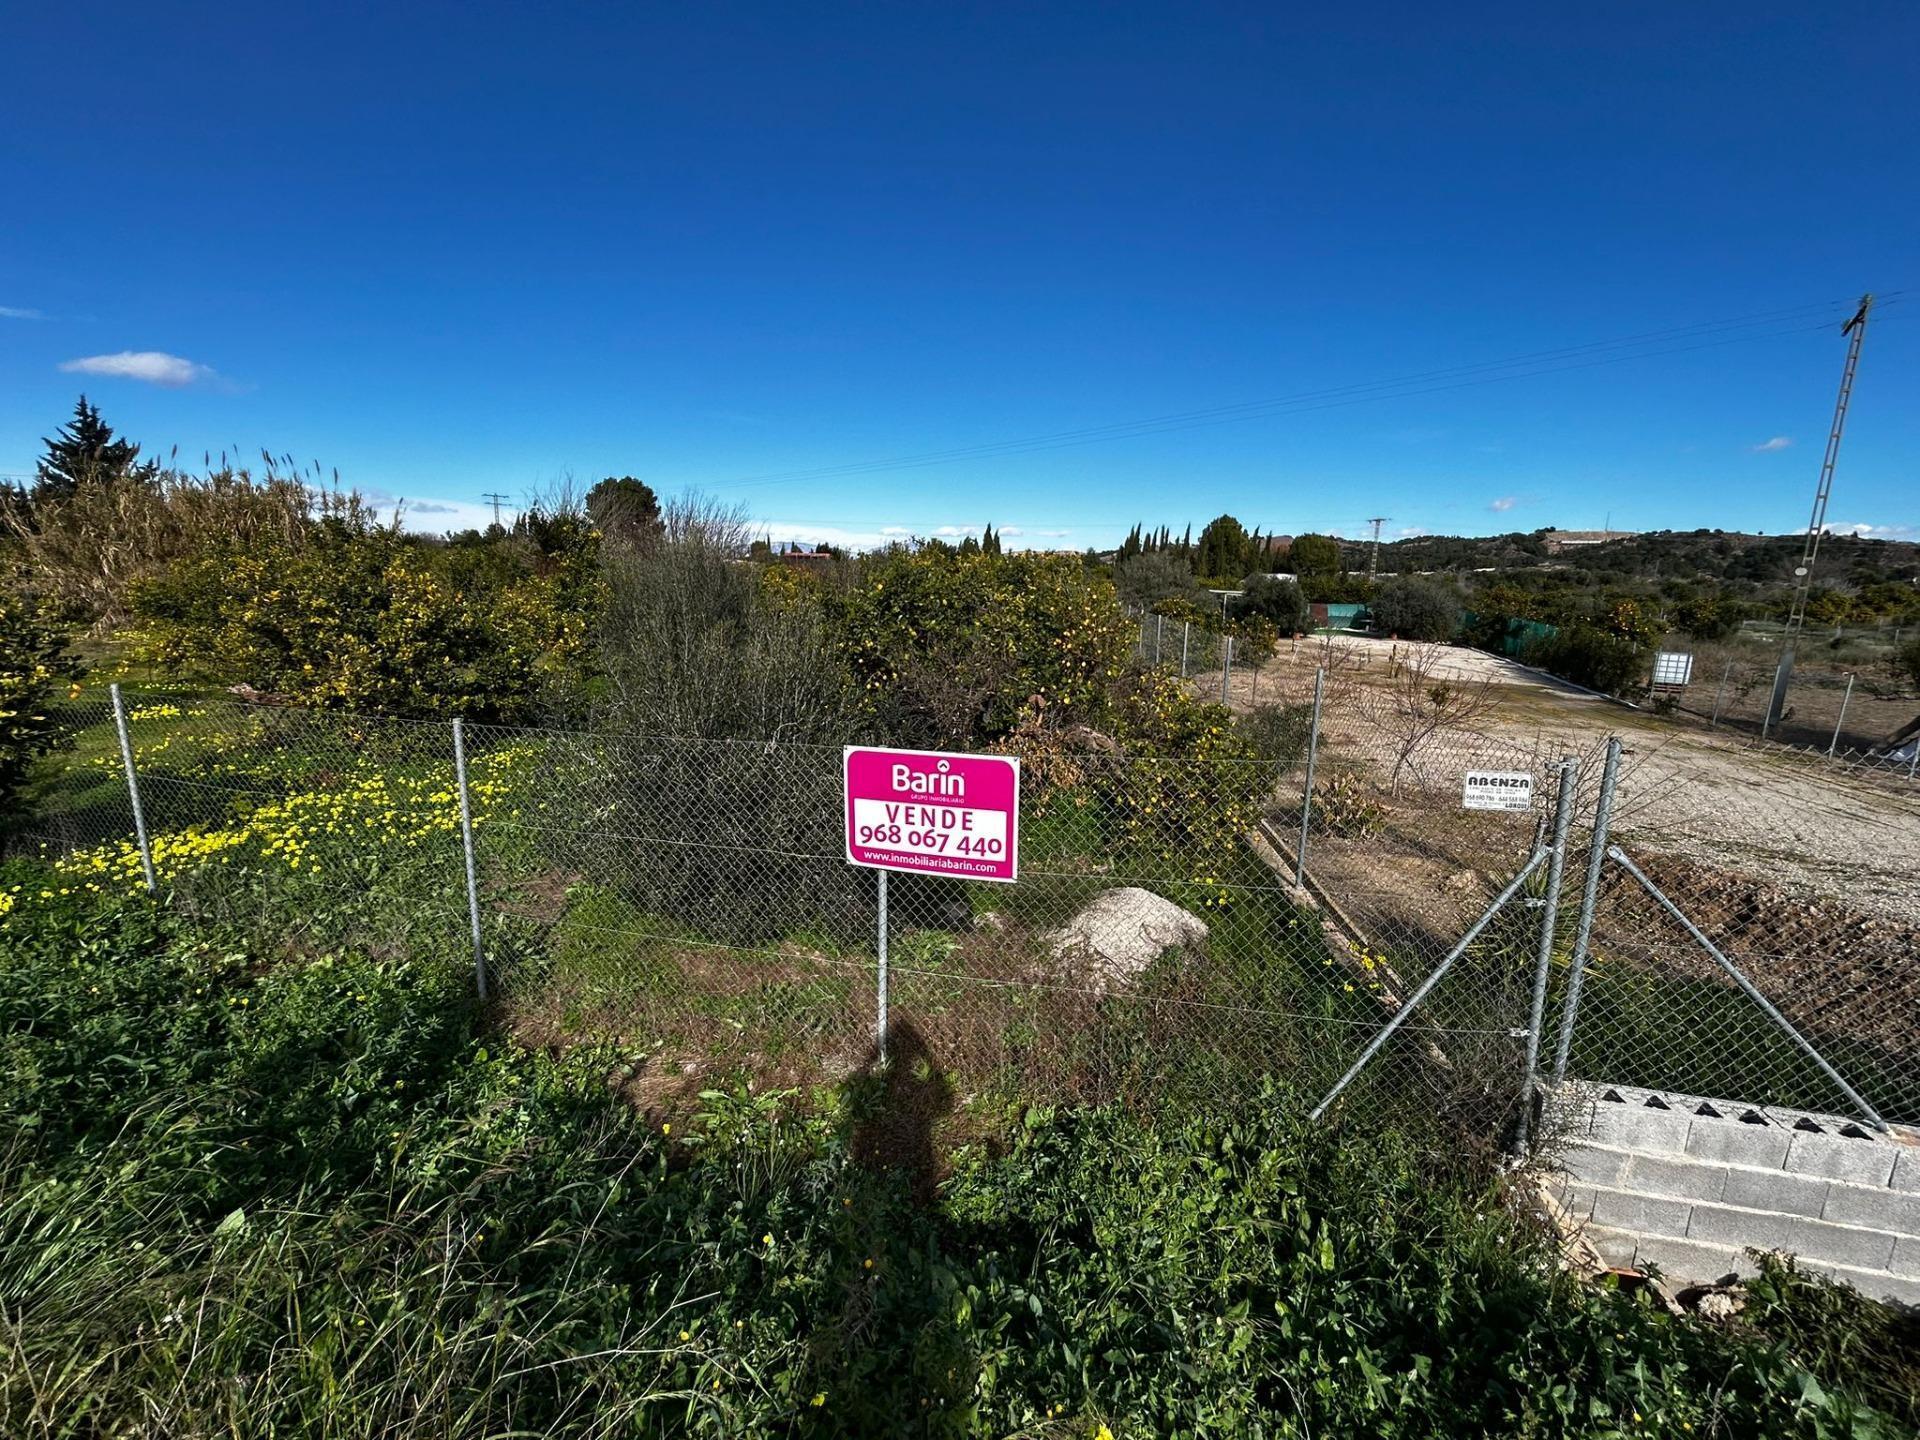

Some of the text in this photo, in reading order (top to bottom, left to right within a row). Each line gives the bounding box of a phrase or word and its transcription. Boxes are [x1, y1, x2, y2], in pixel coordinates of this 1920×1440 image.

[892, 760, 965, 796] Barin
[1468, 776, 1529, 788] ABENZA
[929, 796, 965, 804] INMOBILIARIO
[885, 804, 973, 831] VENDE
[860, 824, 1002, 857] 968 067 440
[864, 850, 997, 873] www.inmobiliariabarin.com
